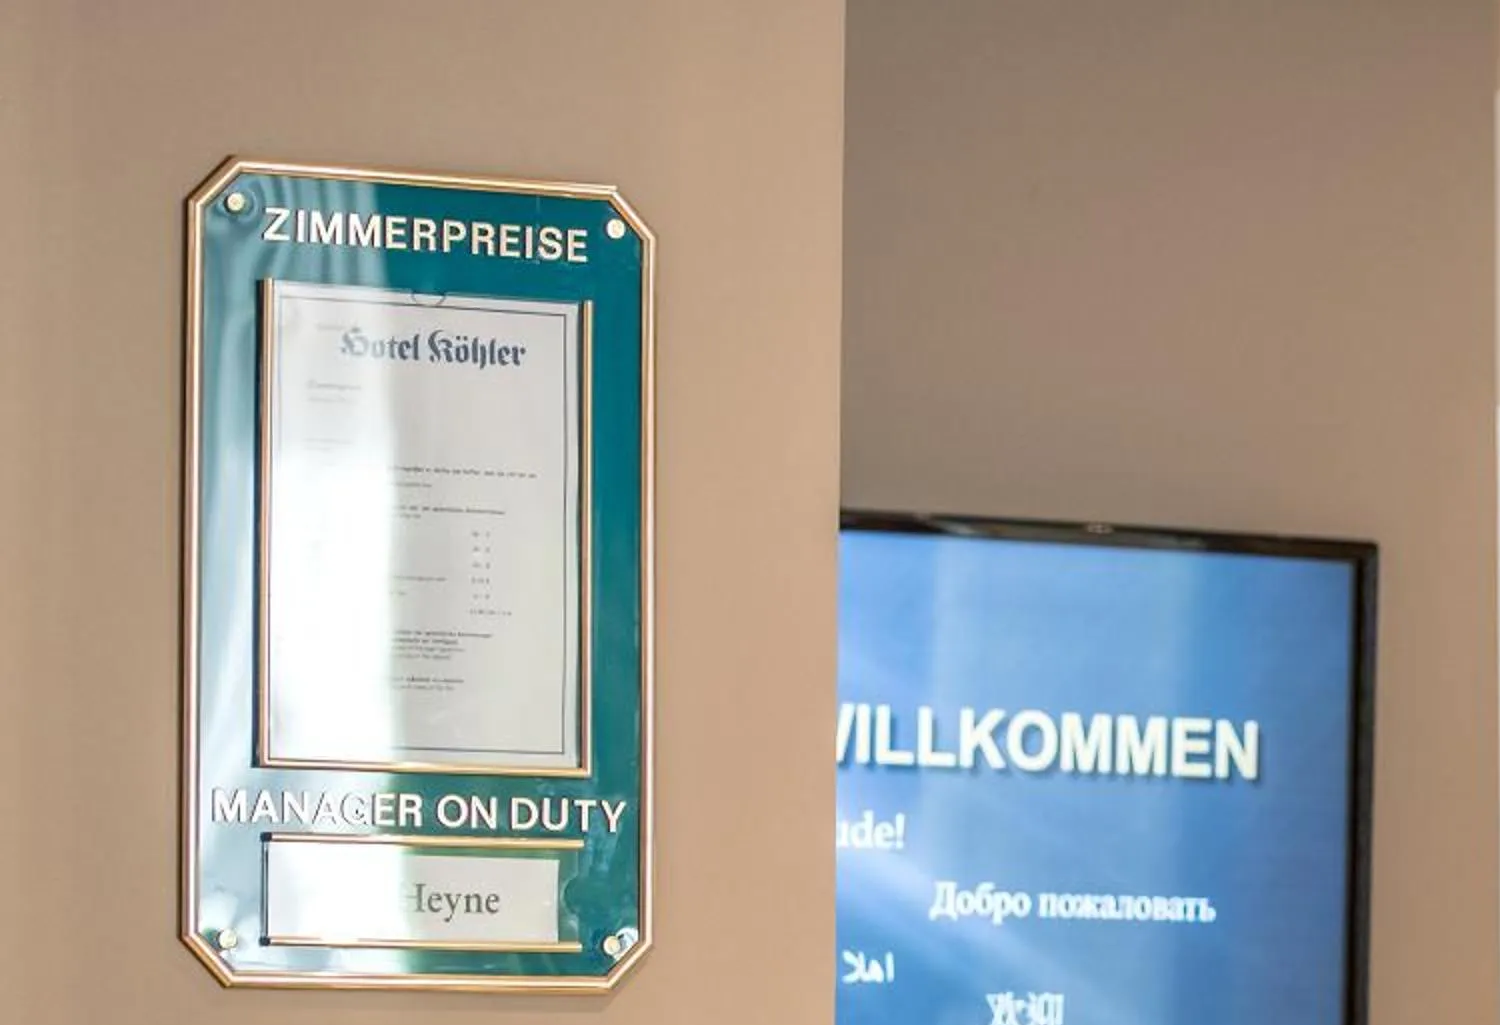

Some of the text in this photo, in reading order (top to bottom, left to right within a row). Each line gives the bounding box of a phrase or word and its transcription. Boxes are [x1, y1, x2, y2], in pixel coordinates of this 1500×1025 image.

[263, 207, 589, 263] ZIMMERPREISE
[340, 327, 527, 371] Hotel Köhler
[212, 788, 627, 834] MANAGER ON DUTY
[929, 881, 1217, 925] Добро пожаловать
